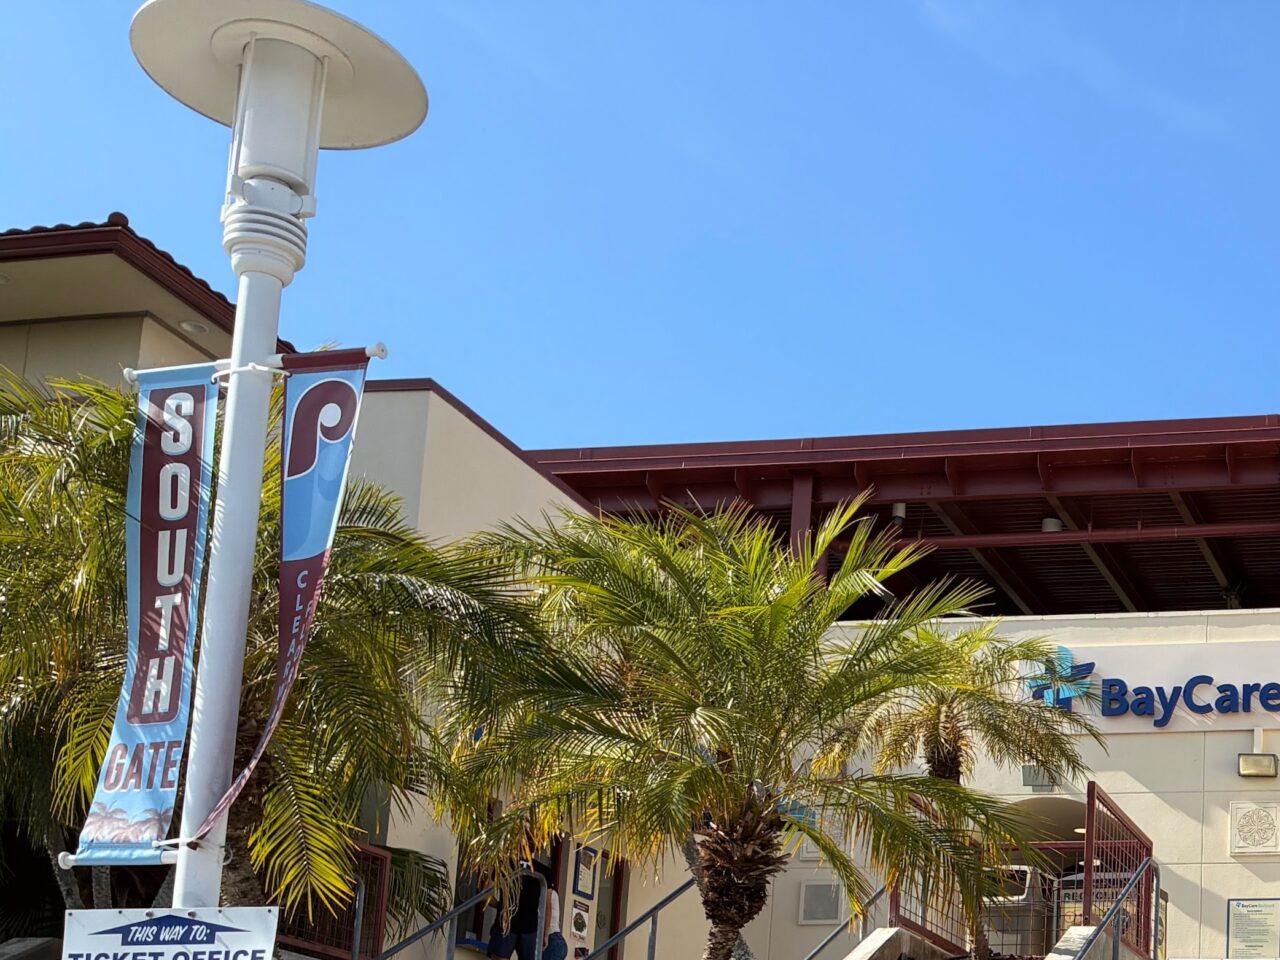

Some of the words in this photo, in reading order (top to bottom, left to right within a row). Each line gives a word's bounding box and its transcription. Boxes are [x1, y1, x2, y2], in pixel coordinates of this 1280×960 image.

[141, 391, 195, 716] SOUTH
[103, 740, 182, 793] GATE
[127, 926, 153, 942] THIS
[159, 926, 188, 942] WAY
[190, 925, 210, 941] TO:
